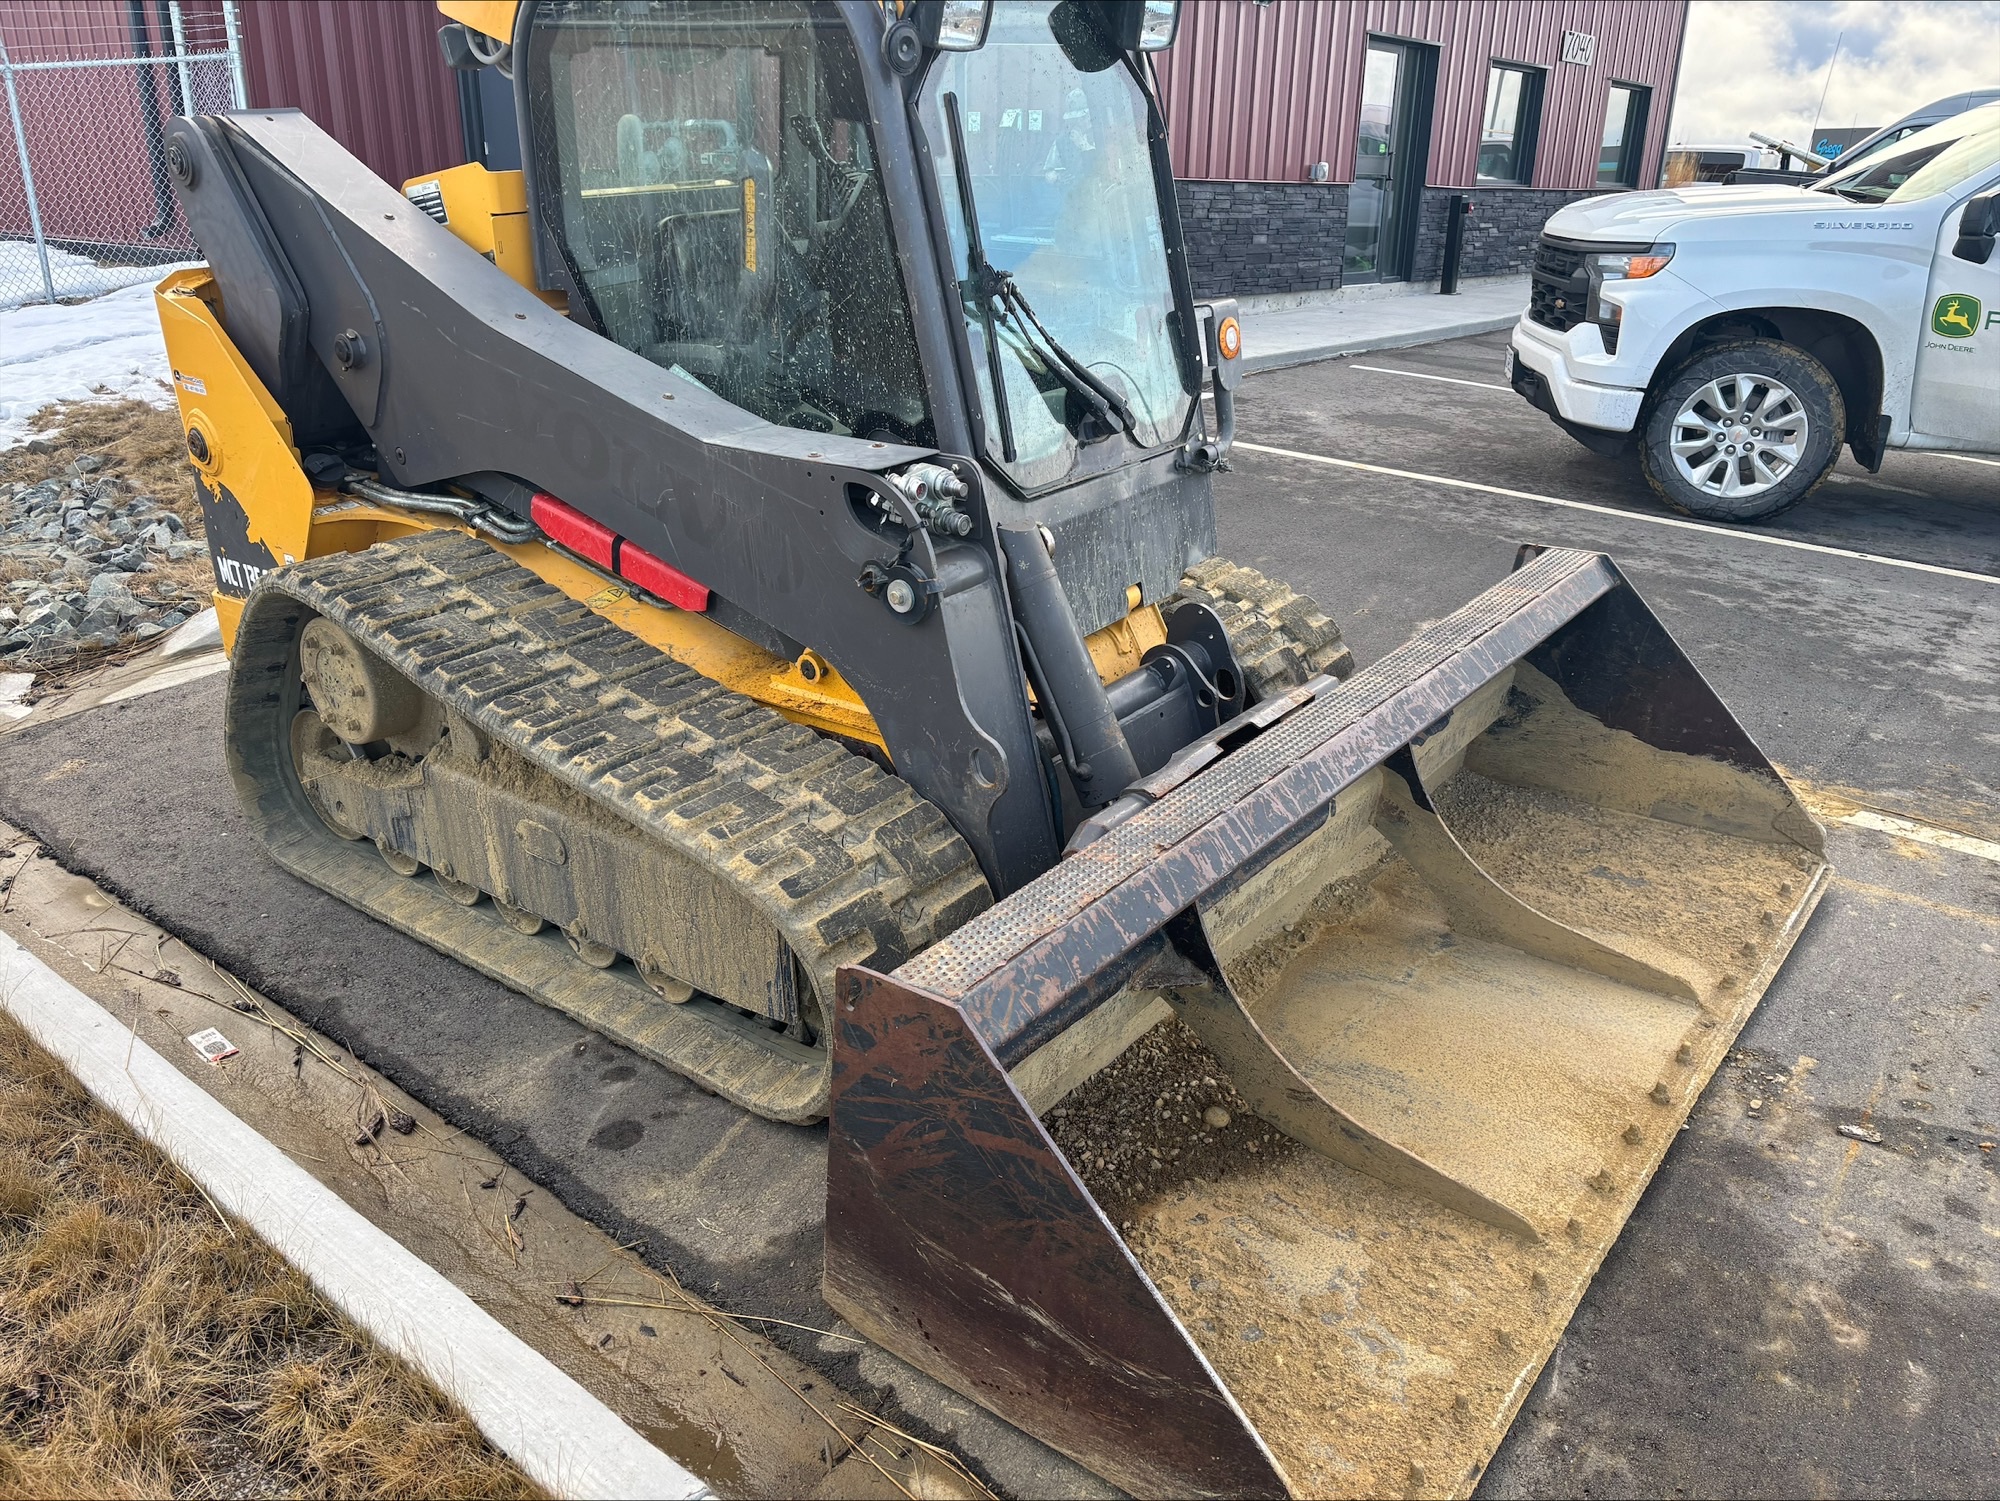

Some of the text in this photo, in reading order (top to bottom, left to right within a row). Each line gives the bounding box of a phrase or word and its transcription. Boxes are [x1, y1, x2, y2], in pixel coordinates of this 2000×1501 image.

[1565, 31, 1593, 63] 7040
[1815, 138, 1843, 159] Gregg
[1813, 222, 1914, 230] SILVERADO
[1924, 341, 1975, 353] JOHN DEERE
[216, 555, 243, 588] MCT
